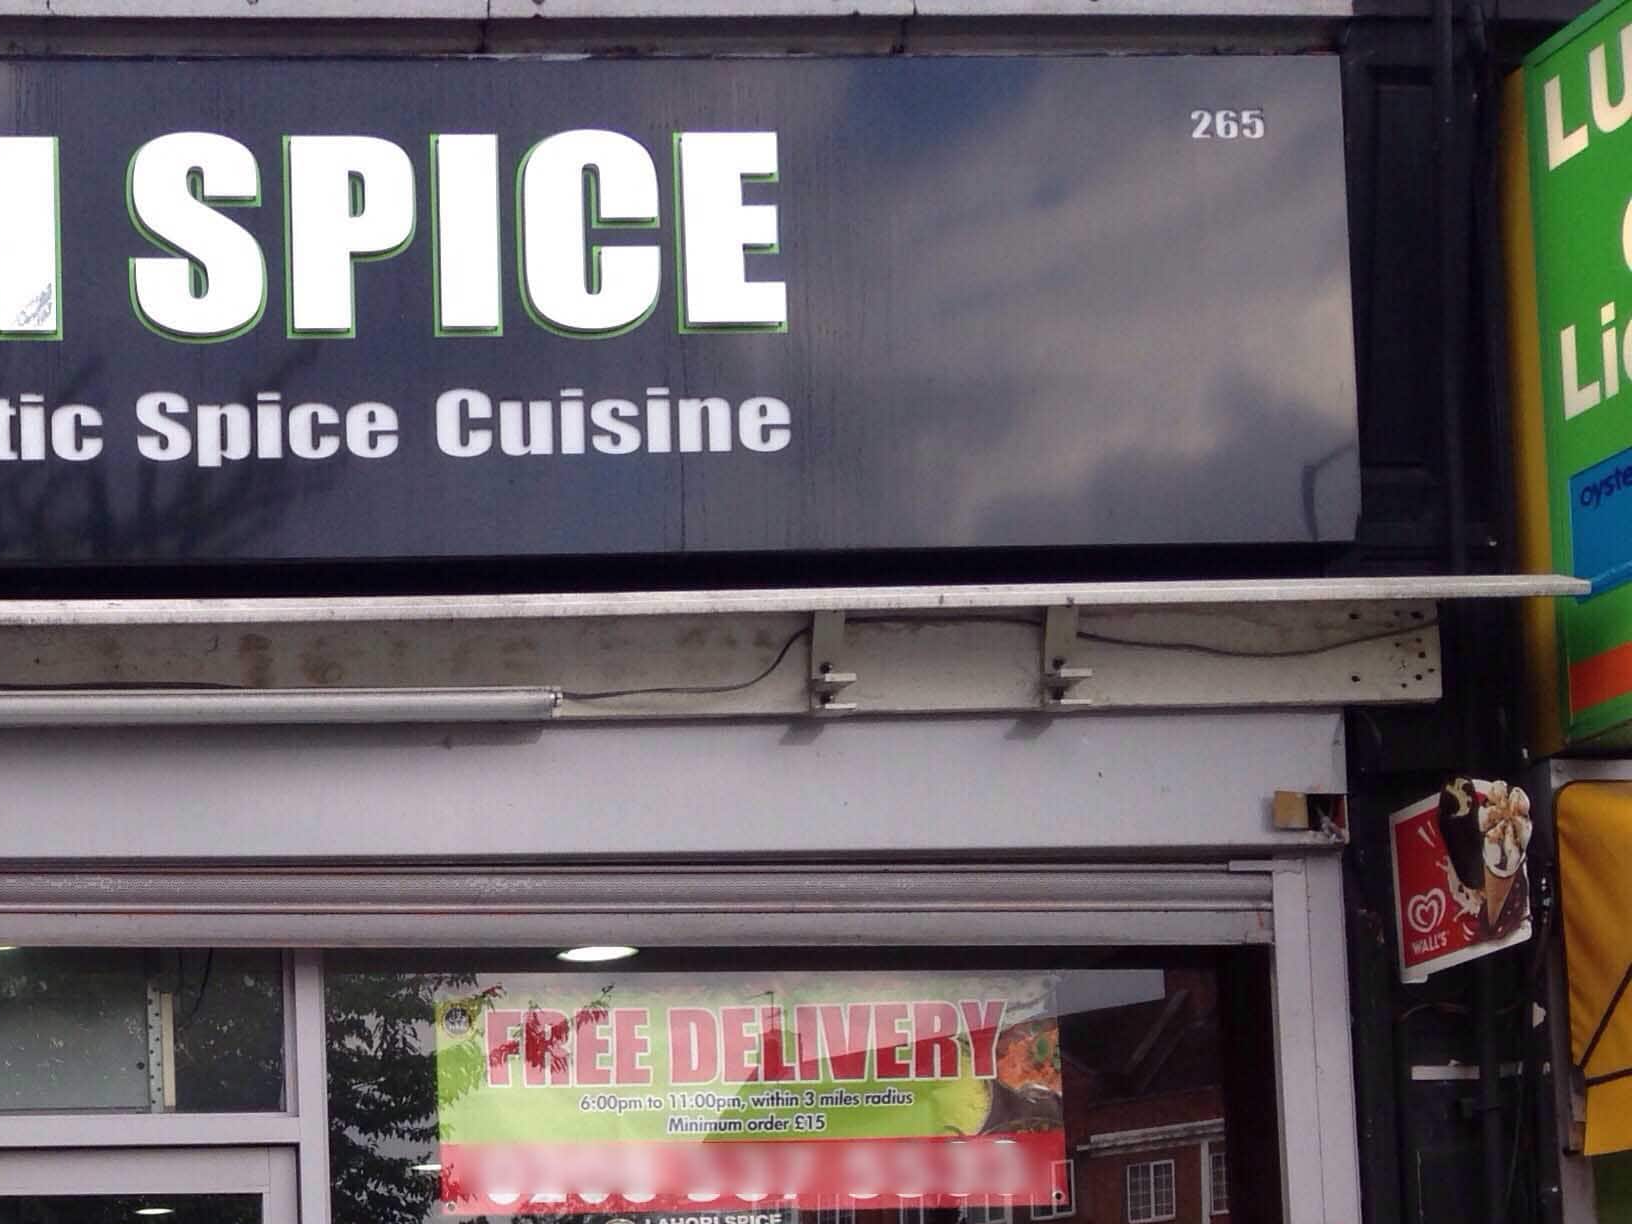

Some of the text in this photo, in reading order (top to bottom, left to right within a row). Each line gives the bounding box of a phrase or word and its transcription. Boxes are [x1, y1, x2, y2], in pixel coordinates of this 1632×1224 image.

[1190, 109, 1265, 139] 265
[126, 129, 789, 341] SPICE
[135, 391, 399, 468] Spice
[436, 386, 791, 457] Cuisine
[484, 1000, 1007, 1087] FREE DELIVERY
[580, 1094, 643, 1114] 6:00pm
[646, 1094, 662, 1109] to
[752, 1090, 799, 1108] within
[804, 1090, 814, 1107] 3
[820, 1089, 860, 1106] miles
[864, 1088, 913, 1106] radius
[668, 1114, 825, 1133] Minimum order £15
